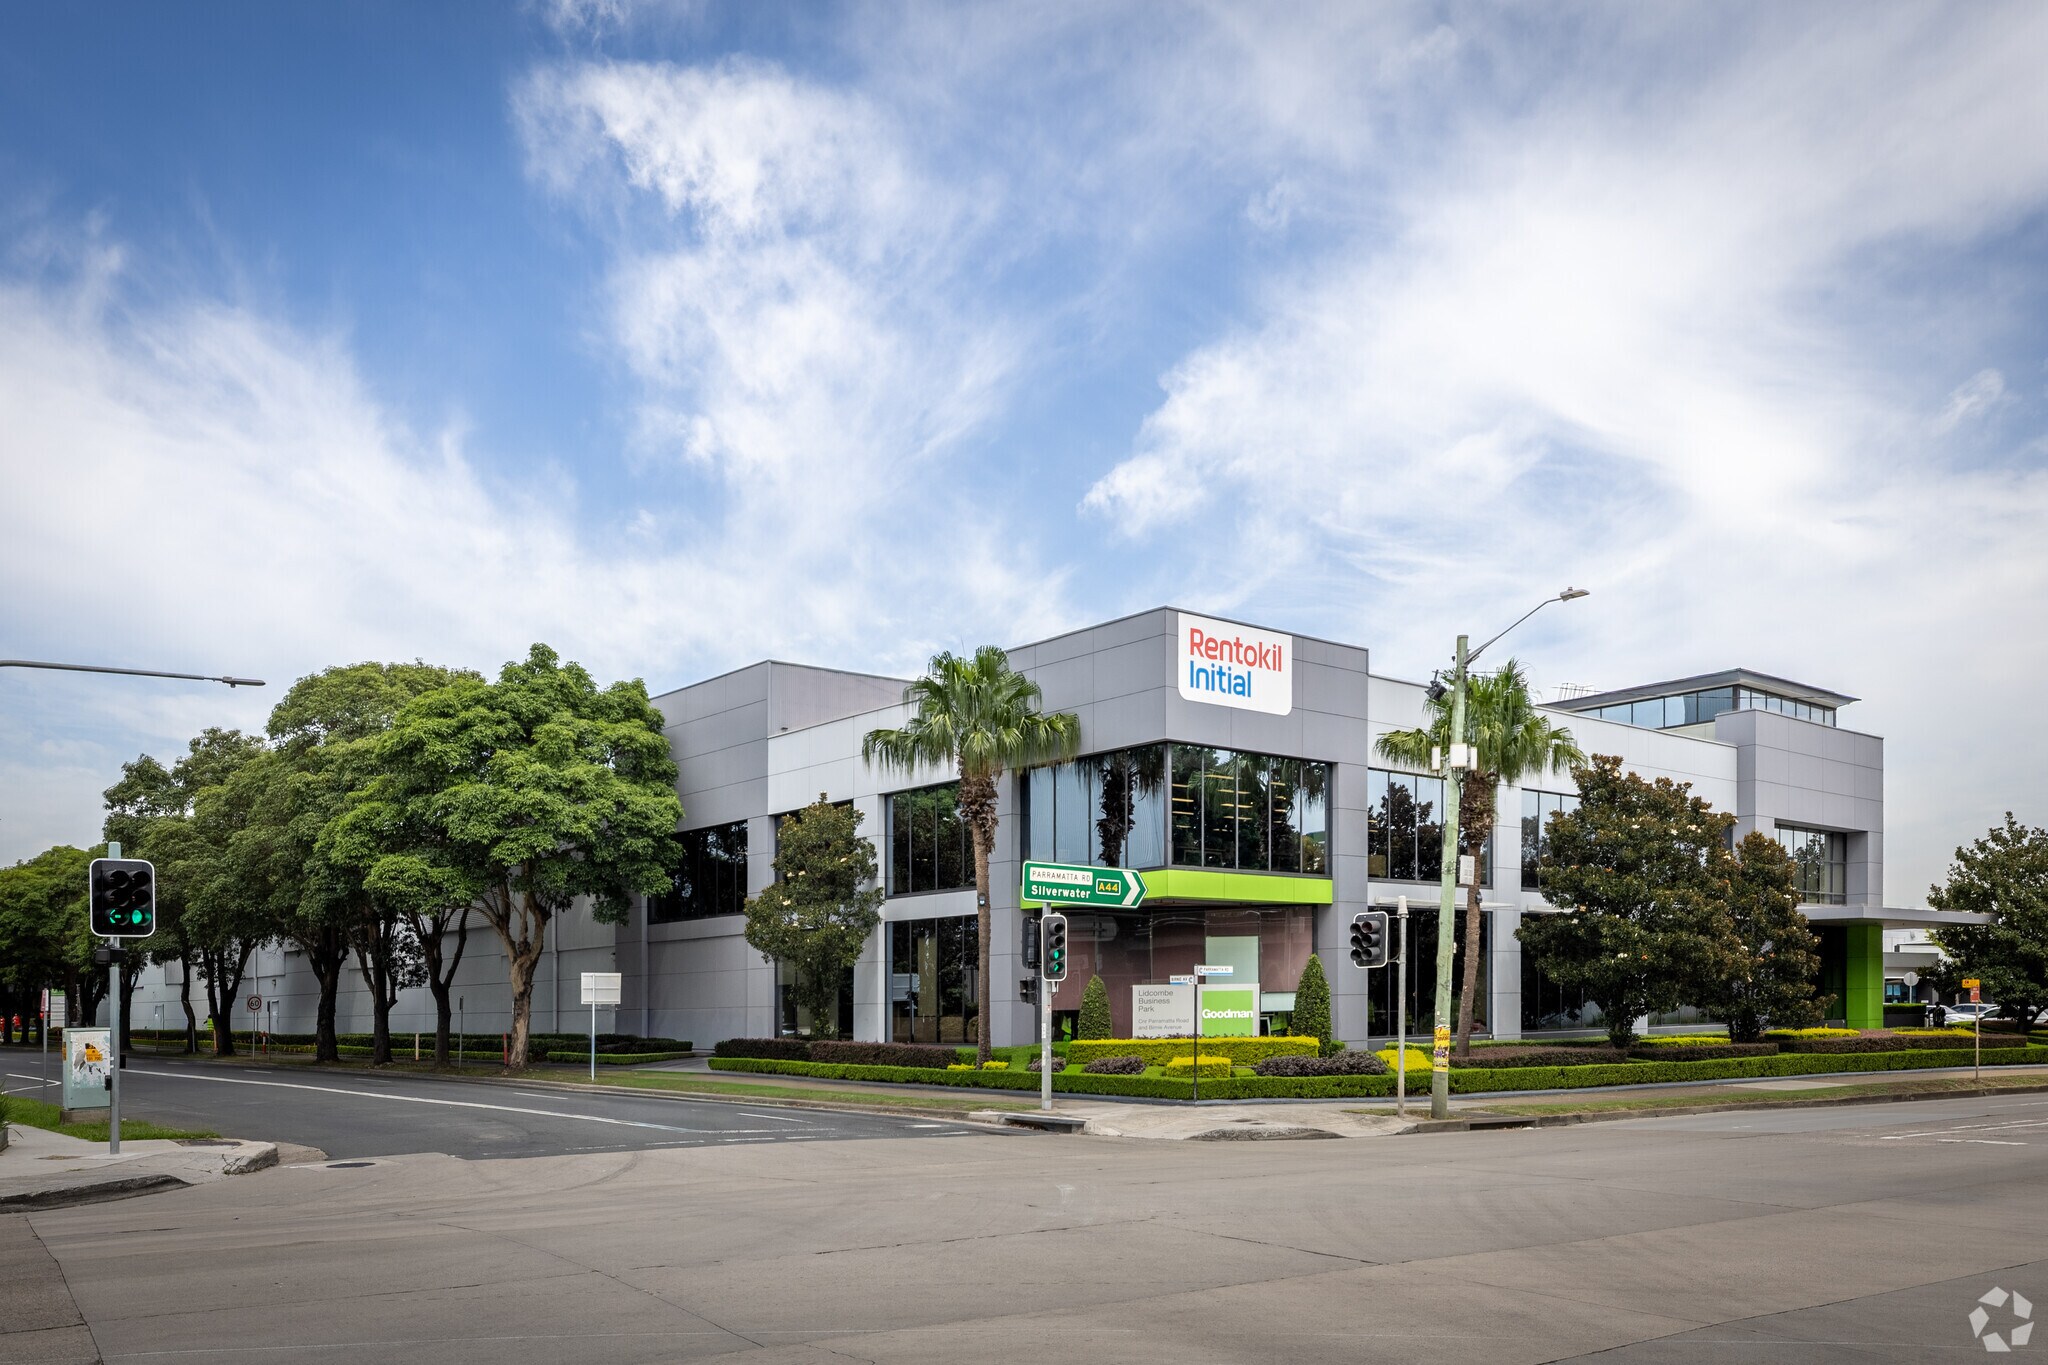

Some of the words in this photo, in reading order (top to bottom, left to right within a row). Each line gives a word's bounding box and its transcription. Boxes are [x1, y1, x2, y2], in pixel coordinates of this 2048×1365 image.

[1190, 627, 1282, 672] Rentokil
[1190, 660, 1252, 698] Initial
[1032, 870, 1079, 881] PARRAMATTA
[1082, 874, 1091, 882] RD
[1031, 884, 1091, 899] Silverwater
[1098, 882, 1118, 892] A44
[1202, 1008, 1254, 1018] Goodman
